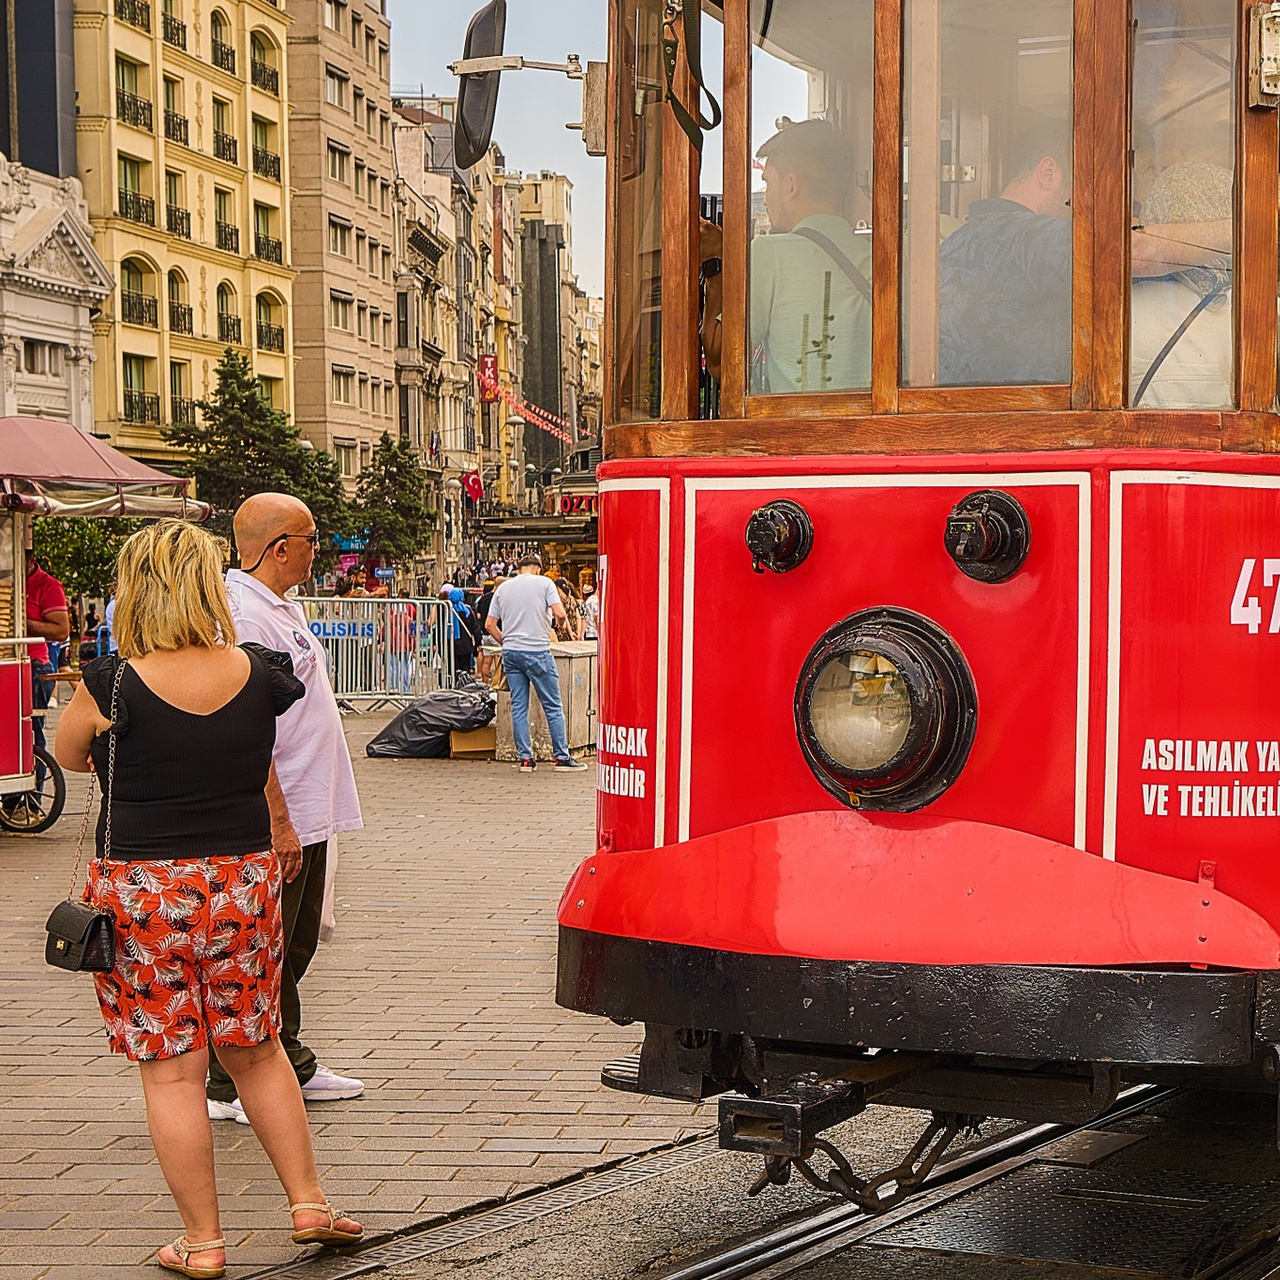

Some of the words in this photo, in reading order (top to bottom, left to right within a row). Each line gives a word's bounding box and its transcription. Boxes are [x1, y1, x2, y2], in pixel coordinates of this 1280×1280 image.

[597, 554, 608, 623] 7
[309, 622, 346, 637] OLiS
[605, 724, 648, 757] YASAK
[1141, 738, 1249, 772] ASILMAK
[1142, 783, 1169, 816] VE
